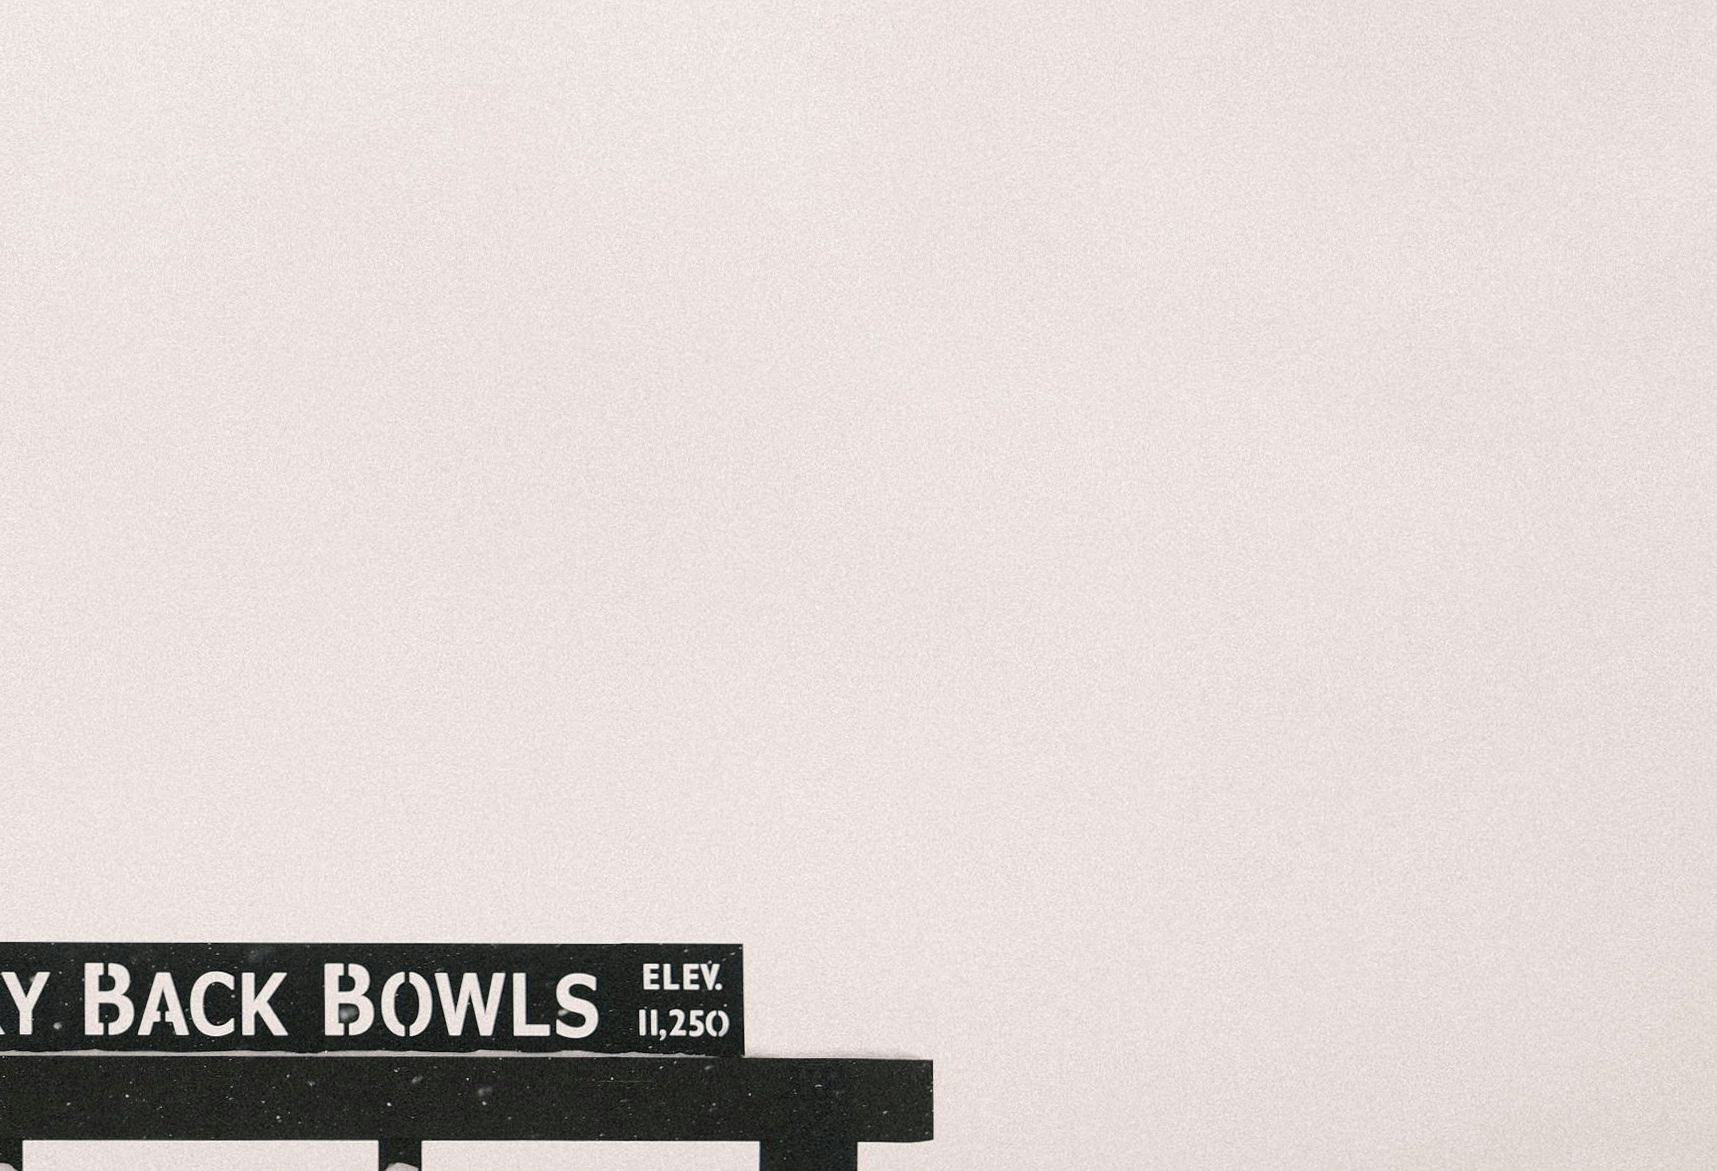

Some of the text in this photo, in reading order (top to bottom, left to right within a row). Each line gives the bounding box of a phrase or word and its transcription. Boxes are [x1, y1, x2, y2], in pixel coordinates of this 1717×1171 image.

[642, 963, 723, 991] ELEV.
[83, 962, 289, 1037] BACK
[323, 962, 599, 1039] BOWLS
[638, 1008, 730, 1040] 11,250
